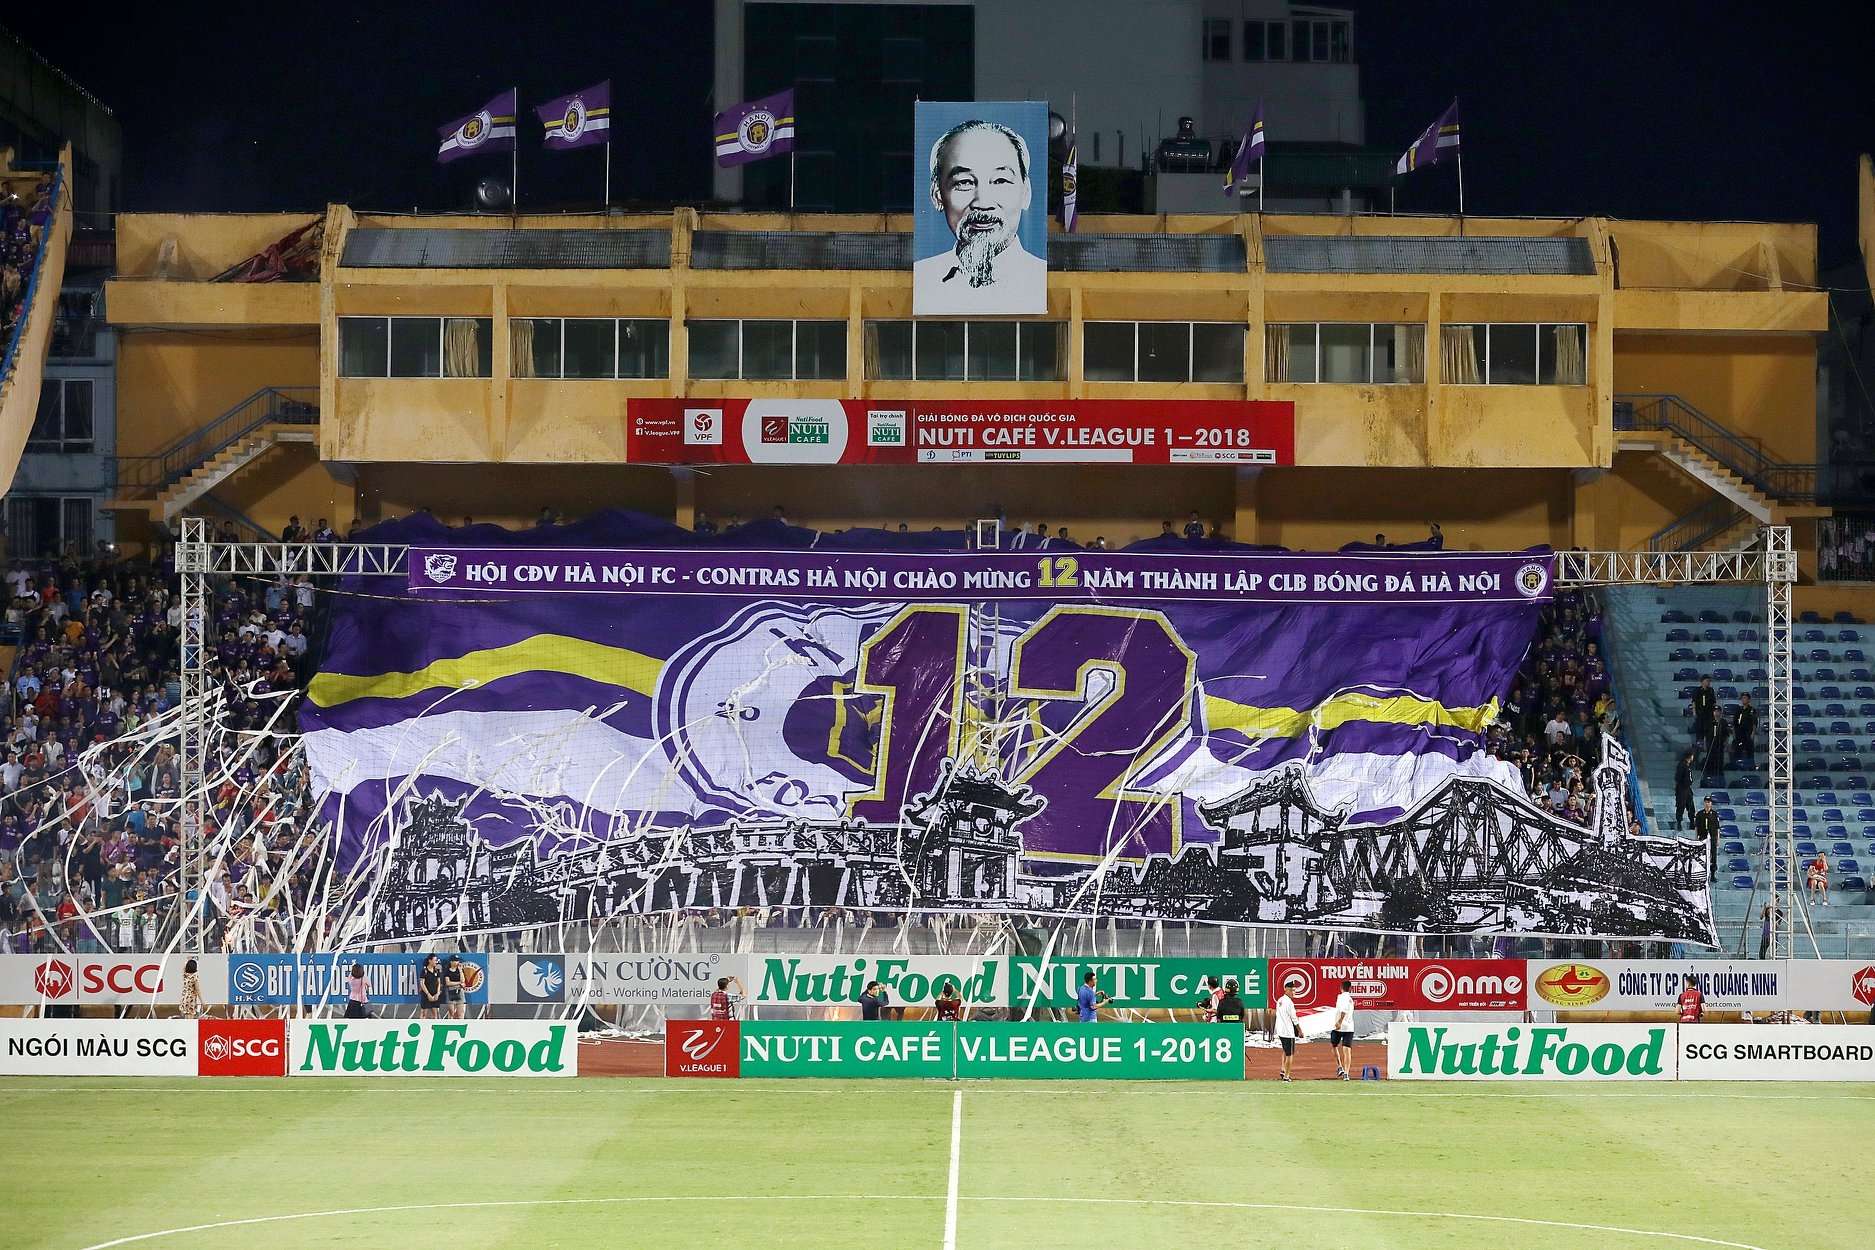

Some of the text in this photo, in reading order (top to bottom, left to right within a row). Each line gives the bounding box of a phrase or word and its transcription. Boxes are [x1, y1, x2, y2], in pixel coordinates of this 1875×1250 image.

[790, 423, 828, 435] NUTI
[873, 427, 900, 436] NUTI
[1004, 414, 1026, 424] ĐỊCH
[1059, 414, 1076, 422] GIA
[694, 433, 713, 441] VPF
[796, 434, 822, 443] CAFÉ
[919, 428, 974, 445] NUTI
[982, 424, 1036, 445] CAFÉ
[1043, 427, 1155, 446] V.LEAGUE
[466, 562, 507, 587] HỘI
[514, 564, 558, 582] CĐV
[564, 561, 597, 583] HÀ
[601, 562, 645, 588] NỘI
[651, 566, 676, 584] FC
[696, 567, 800, 587] CONTRAS
[807, 565, 837, 587] HÀ
[844, 567, 887, 592] NỘI
[893, 566, 956, 588] CHÀO
[964, 565, 1031, 589] MỪNG
[1037, 556, 1078, 588] 12
[1083, 563, 1134, 589] NĂM
[1140, 567, 1217, 590] THÀNH
[1224, 570, 1263, 595] LẬP
[1268, 574, 1307, 592] CLB
[1313, 569, 1379, 593] BÓNG
[1385, 569, 1416, 593] ĐÁ
[1421, 570, 1453, 593] HÀ
[1459, 569, 1501, 595] NỘI
[1521, 565, 1544, 574] HANOI
[843, 603, 1198, 864] 12
[83, 964, 164, 994] SCG
[267, 959, 293, 996] BÍT
[364, 964, 393, 996] KIM
[398, 959, 419, 996] HÀ
[571, 955, 712, 982] AN CƯỜNG
[757, 958, 998, 1003] NutiFood
[1017, 962, 1161, 1001] NUTI
[1320, 961, 1409, 979] TRUYỀN HÌNH
[1618, 967, 1648, 996] CÔNG
[1649, 973, 1663, 996] TY
[1665, 973, 1679, 996] CP
[1713, 964, 1749, 997] QUẢNG
[1751, 972, 1778, 997] NINH
[613, 987, 658, 999] Working
[662, 987, 711, 998] Materials
[8, 1033, 187, 1058] NGÓI MÀU SCG
[232, 1038, 279, 1057] SCG
[300, 1022, 567, 1074] NutiFood
[743, 1030, 942, 1063] NUTI CAFÉ
[959, 1036, 1232, 1063] V.LEAGUE 1-2018
[1399, 1026, 1667, 1076] NutiFood
[1686, 1044, 1874, 1061] SCG SMARTBOARD
